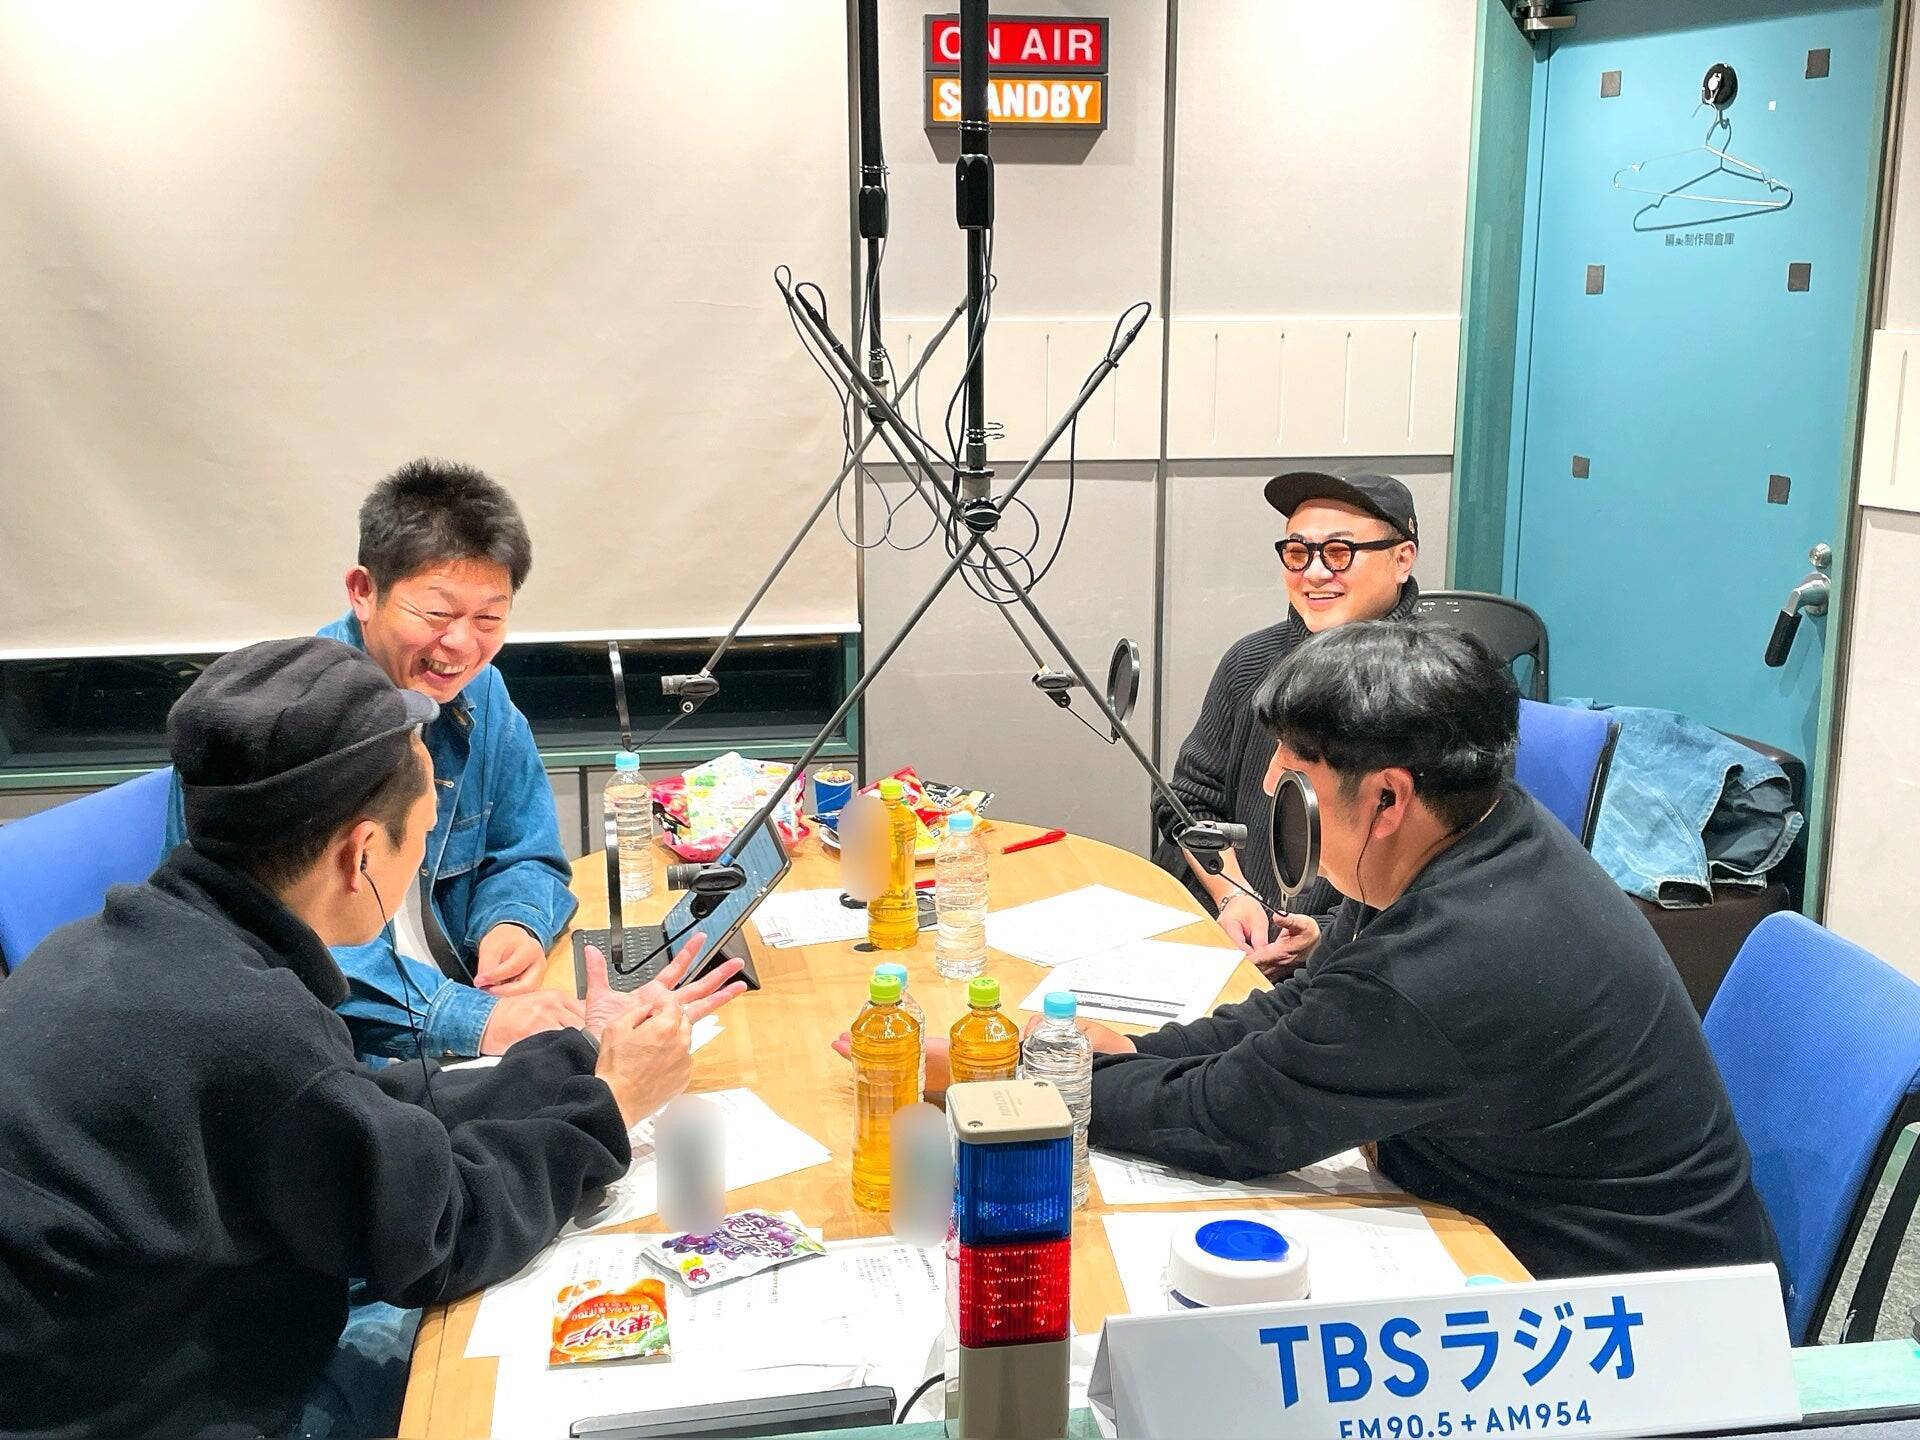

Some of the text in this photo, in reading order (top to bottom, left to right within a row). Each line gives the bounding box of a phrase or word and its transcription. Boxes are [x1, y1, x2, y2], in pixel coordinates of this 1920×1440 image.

[1020, 28, 1094, 61] AIR
[938, 81, 1094, 118] SANDBY
[1259, 1295, 1644, 1409] TBSラジオ
